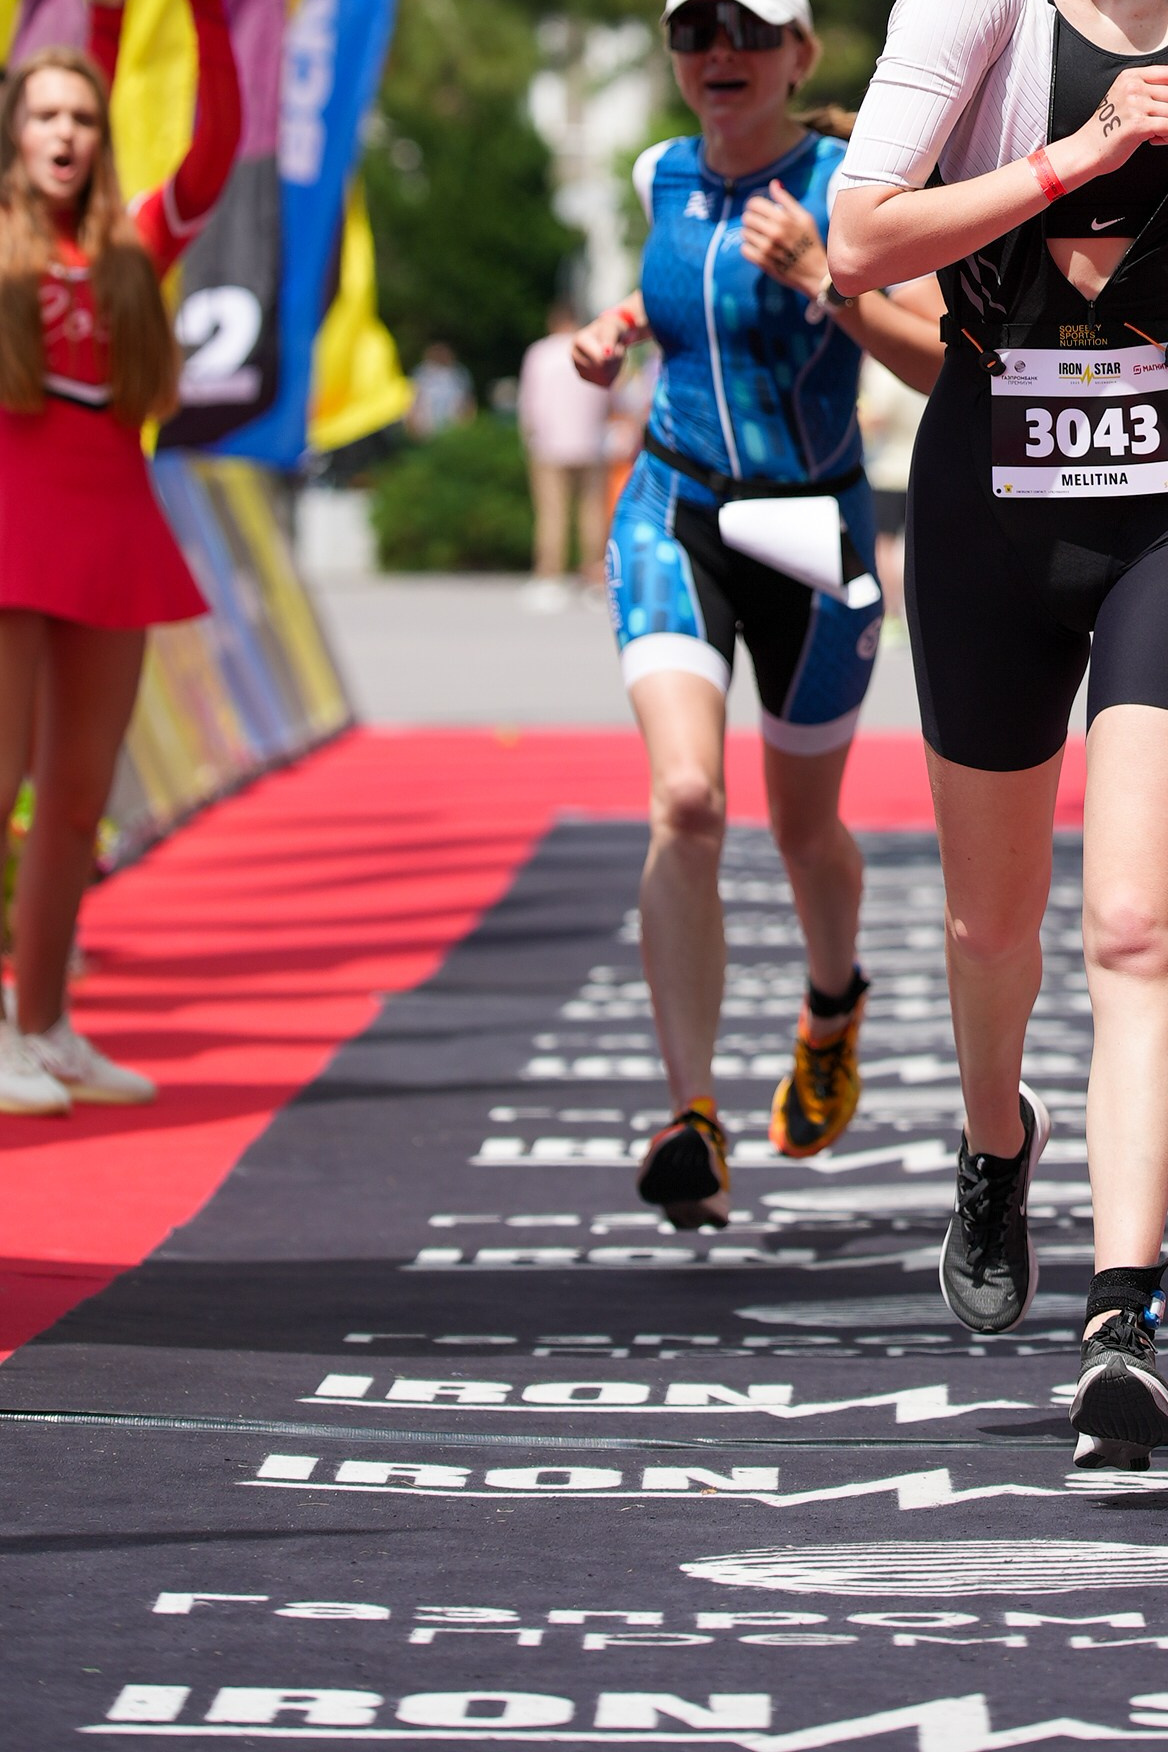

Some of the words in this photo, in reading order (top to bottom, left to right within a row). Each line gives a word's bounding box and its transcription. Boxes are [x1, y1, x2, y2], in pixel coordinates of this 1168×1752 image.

[1059, 324, 1102, 333] SQUEEY
[1059, 338, 1108, 347] NUTRITION
[1058, 362, 1082, 375] IRON
[1094, 361, 1121, 375] STAR
[1025, 404, 1161, 458] 3043
[1061, 472, 1129, 486] MELITINA
[318, 1374, 793, 1406] IRON
[255, 1455, 780, 1491] IRON
[106, 1684, 773, 1729] IRON
